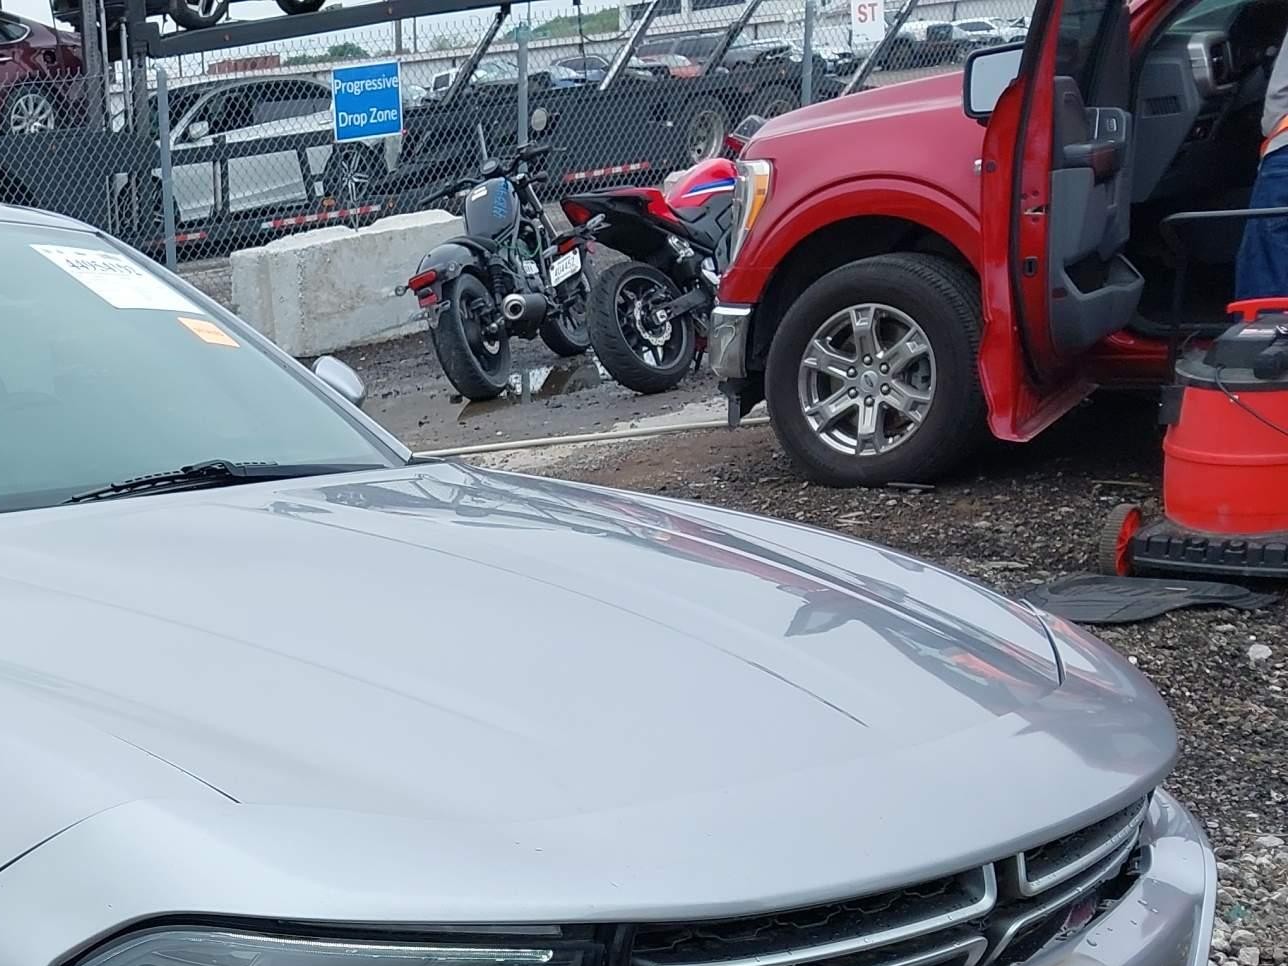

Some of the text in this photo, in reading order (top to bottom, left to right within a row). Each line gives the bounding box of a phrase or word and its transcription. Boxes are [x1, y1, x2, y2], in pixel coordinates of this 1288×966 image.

[857, 3, 878, 23] ST
[334, 74, 399, 95] Progressive
[338, 108, 398, 128] Drop Zone
